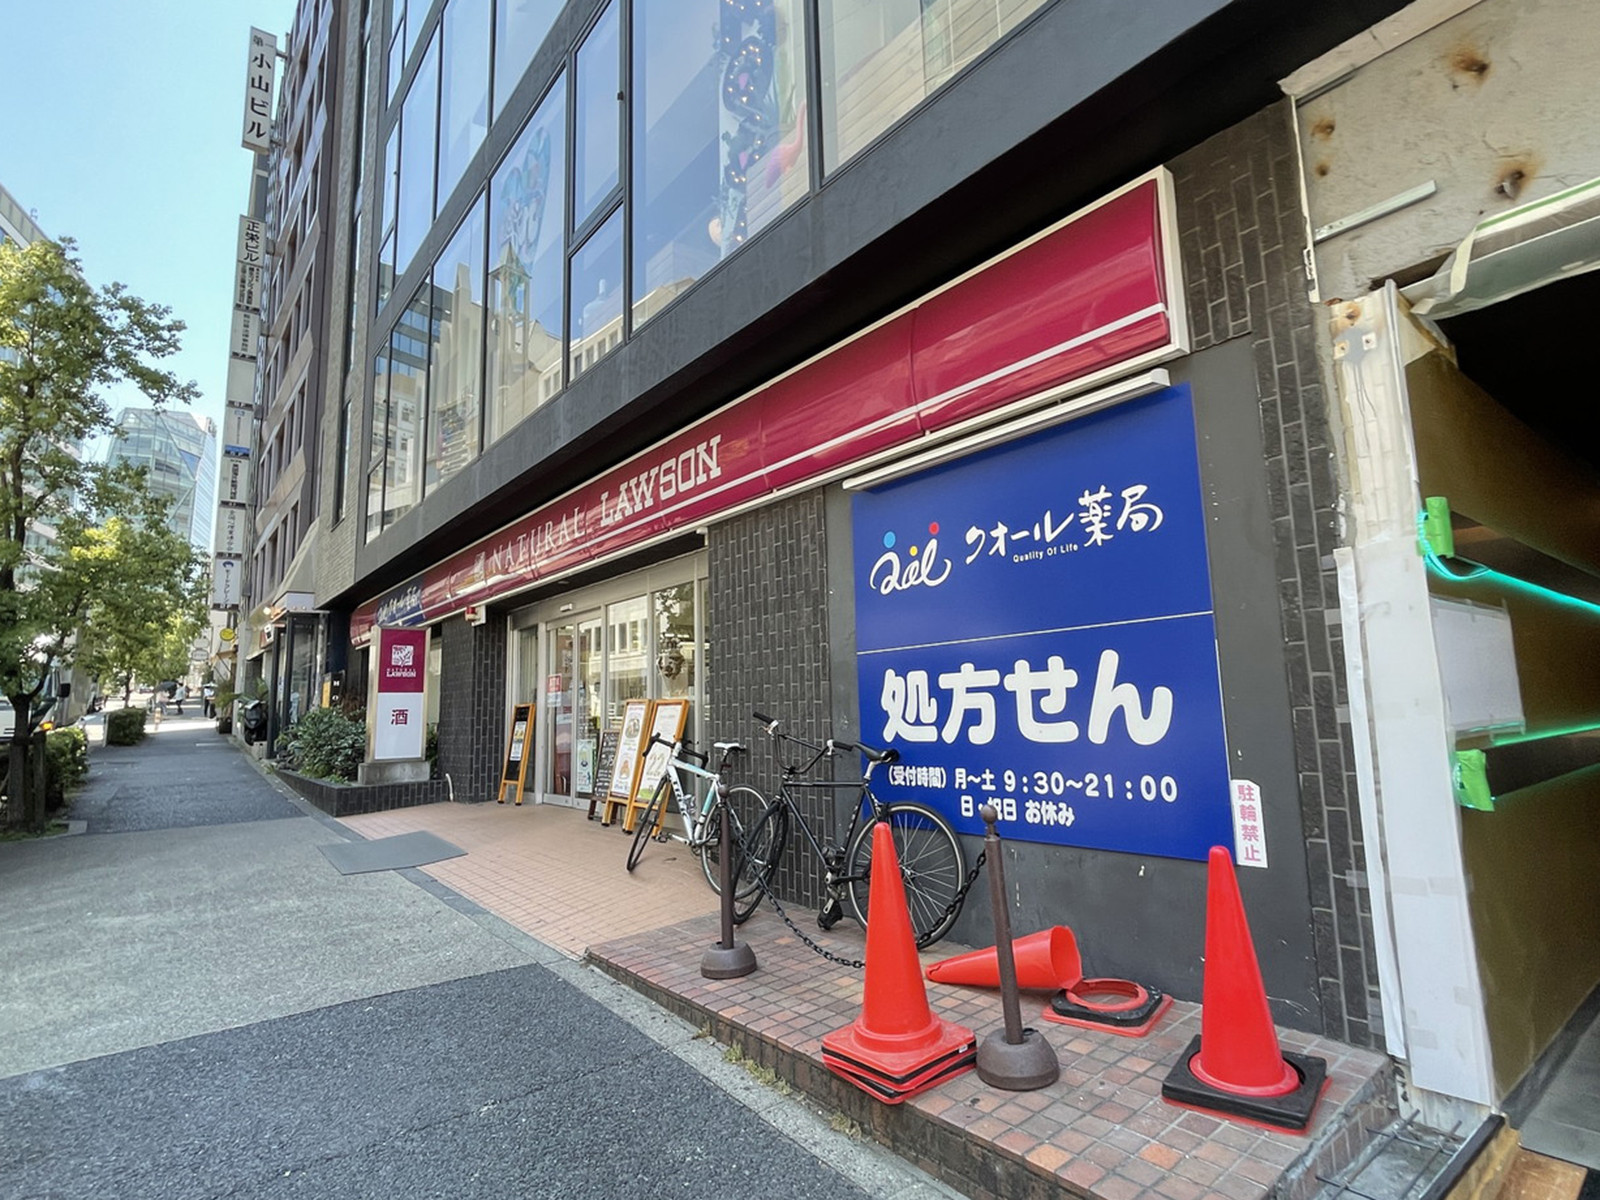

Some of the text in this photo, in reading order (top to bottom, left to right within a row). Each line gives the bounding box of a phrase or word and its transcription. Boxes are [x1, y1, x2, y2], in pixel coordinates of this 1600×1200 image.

[247, 53, 272, 139] 小山ビル
[491, 434, 722, 573] NATURAL LAWSON
[964, 484, 1164, 565] クオール薬局
[1012, 543, 1079, 563] Quality Of Life
[390, 709, 409, 725] 酒
[880, 648, 1174, 746] 処方せん
[1024, 799, 1075, 827] お休み
[1237, 784, 1262, 862] 駐輪禁止
